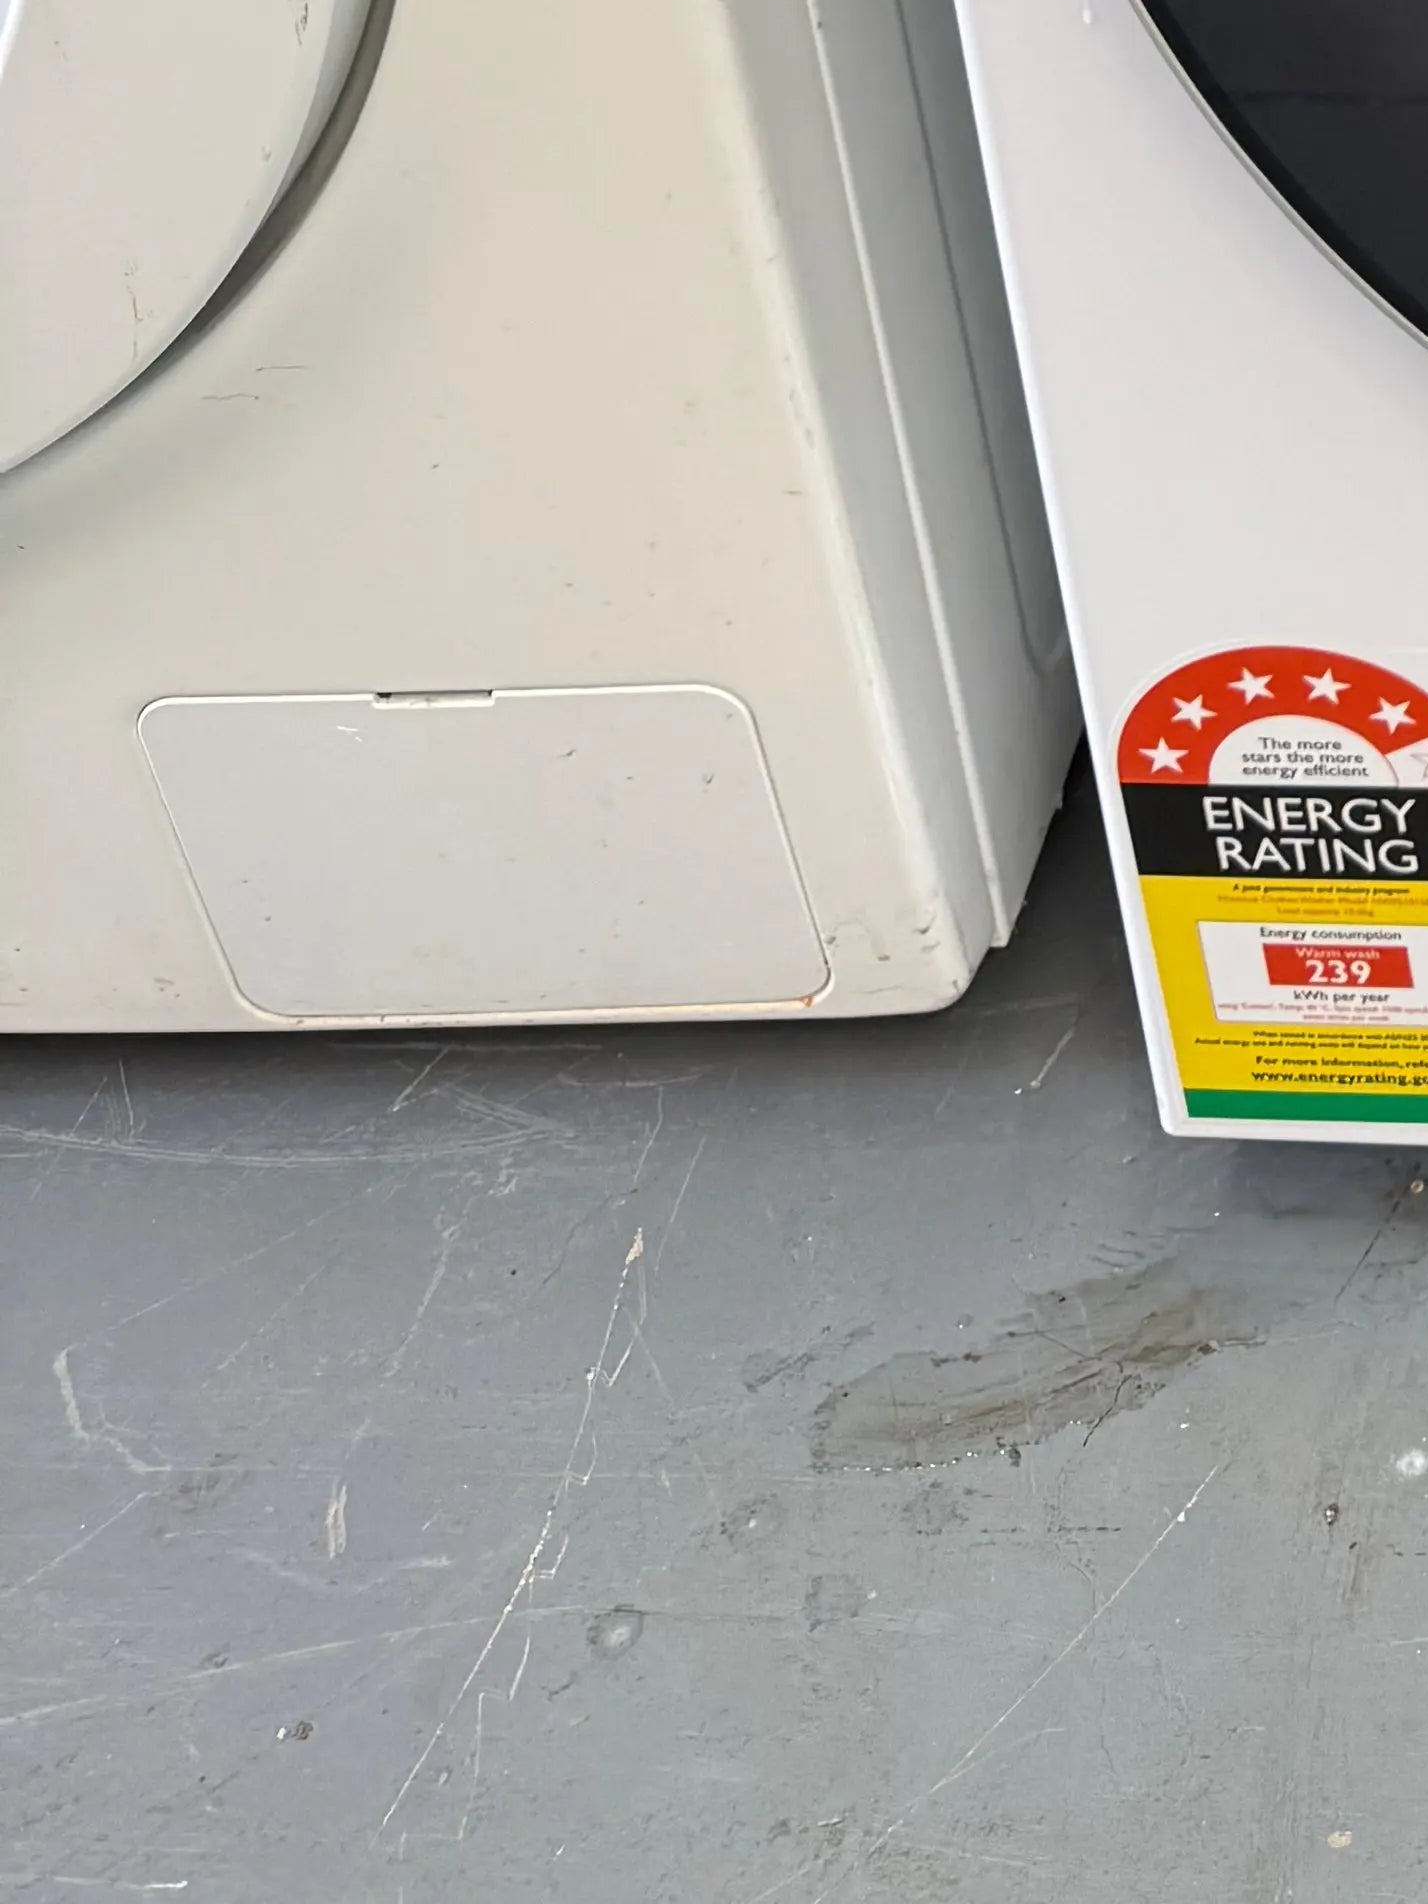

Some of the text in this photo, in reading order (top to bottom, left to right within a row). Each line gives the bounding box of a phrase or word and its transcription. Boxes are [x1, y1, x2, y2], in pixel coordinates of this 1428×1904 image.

[1258, 737, 1342, 750] The more
[1242, 751, 1364, 764] stars the more
[1242, 764, 1369, 780] energy efficient
[1202, 796, 1416, 833] ENERGY
[1216, 838, 1419, 873] RATING
[1260, 927, 1402, 942] Energy consumption
[1296, 948, 1380, 959] Warm wash
[1305, 961, 1371, 984] 239
[1293, 990, 1390, 1003] kWh per year
[1256, 1056, 1278, 1065] For
